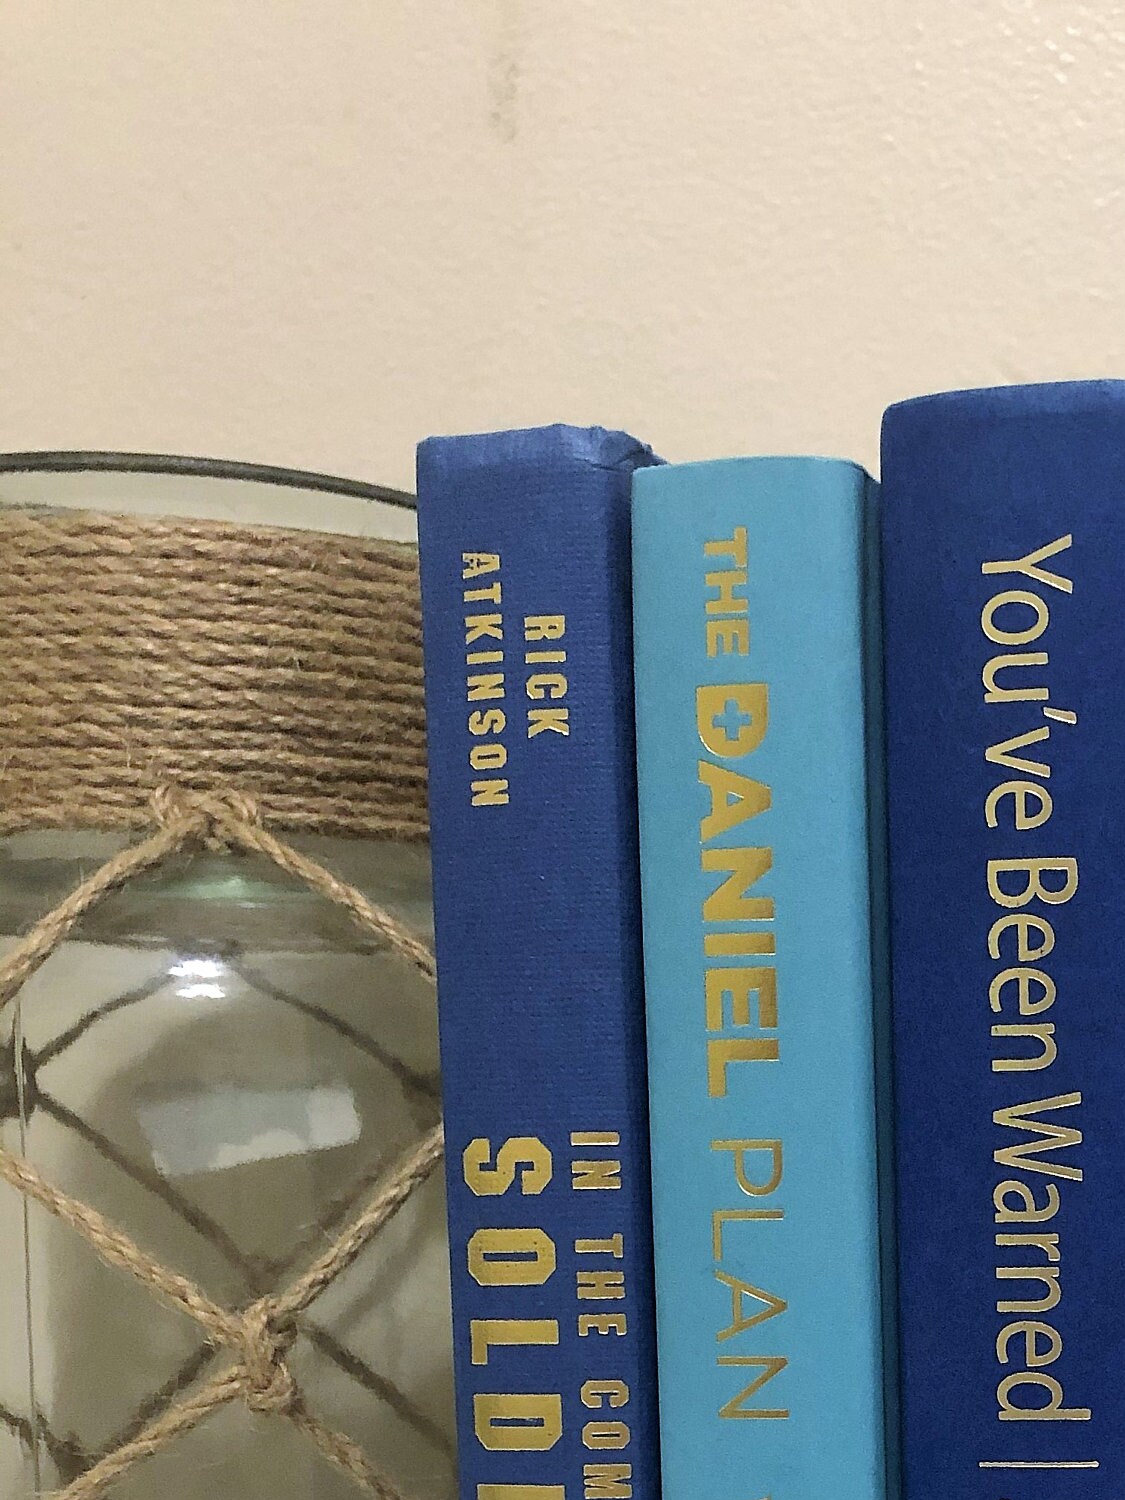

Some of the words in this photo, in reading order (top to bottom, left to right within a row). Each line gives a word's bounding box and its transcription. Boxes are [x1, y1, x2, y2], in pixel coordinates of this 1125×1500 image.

[462, 552, 509, 807] ATKINSON
[524, 614, 570, 737] RICK
[704, 525, 750, 658] THE
[981, 534, 1078, 831] You've
[695, 681, 780, 1098] DANIEL
[986, 856, 1079, 1072] Been
[570, 1131, 622, 1190] IN
[992, 1091, 1092, 1422] Warned
[575, 1233, 627, 1336] THE
[709, 1138, 791, 1420] PLAN
